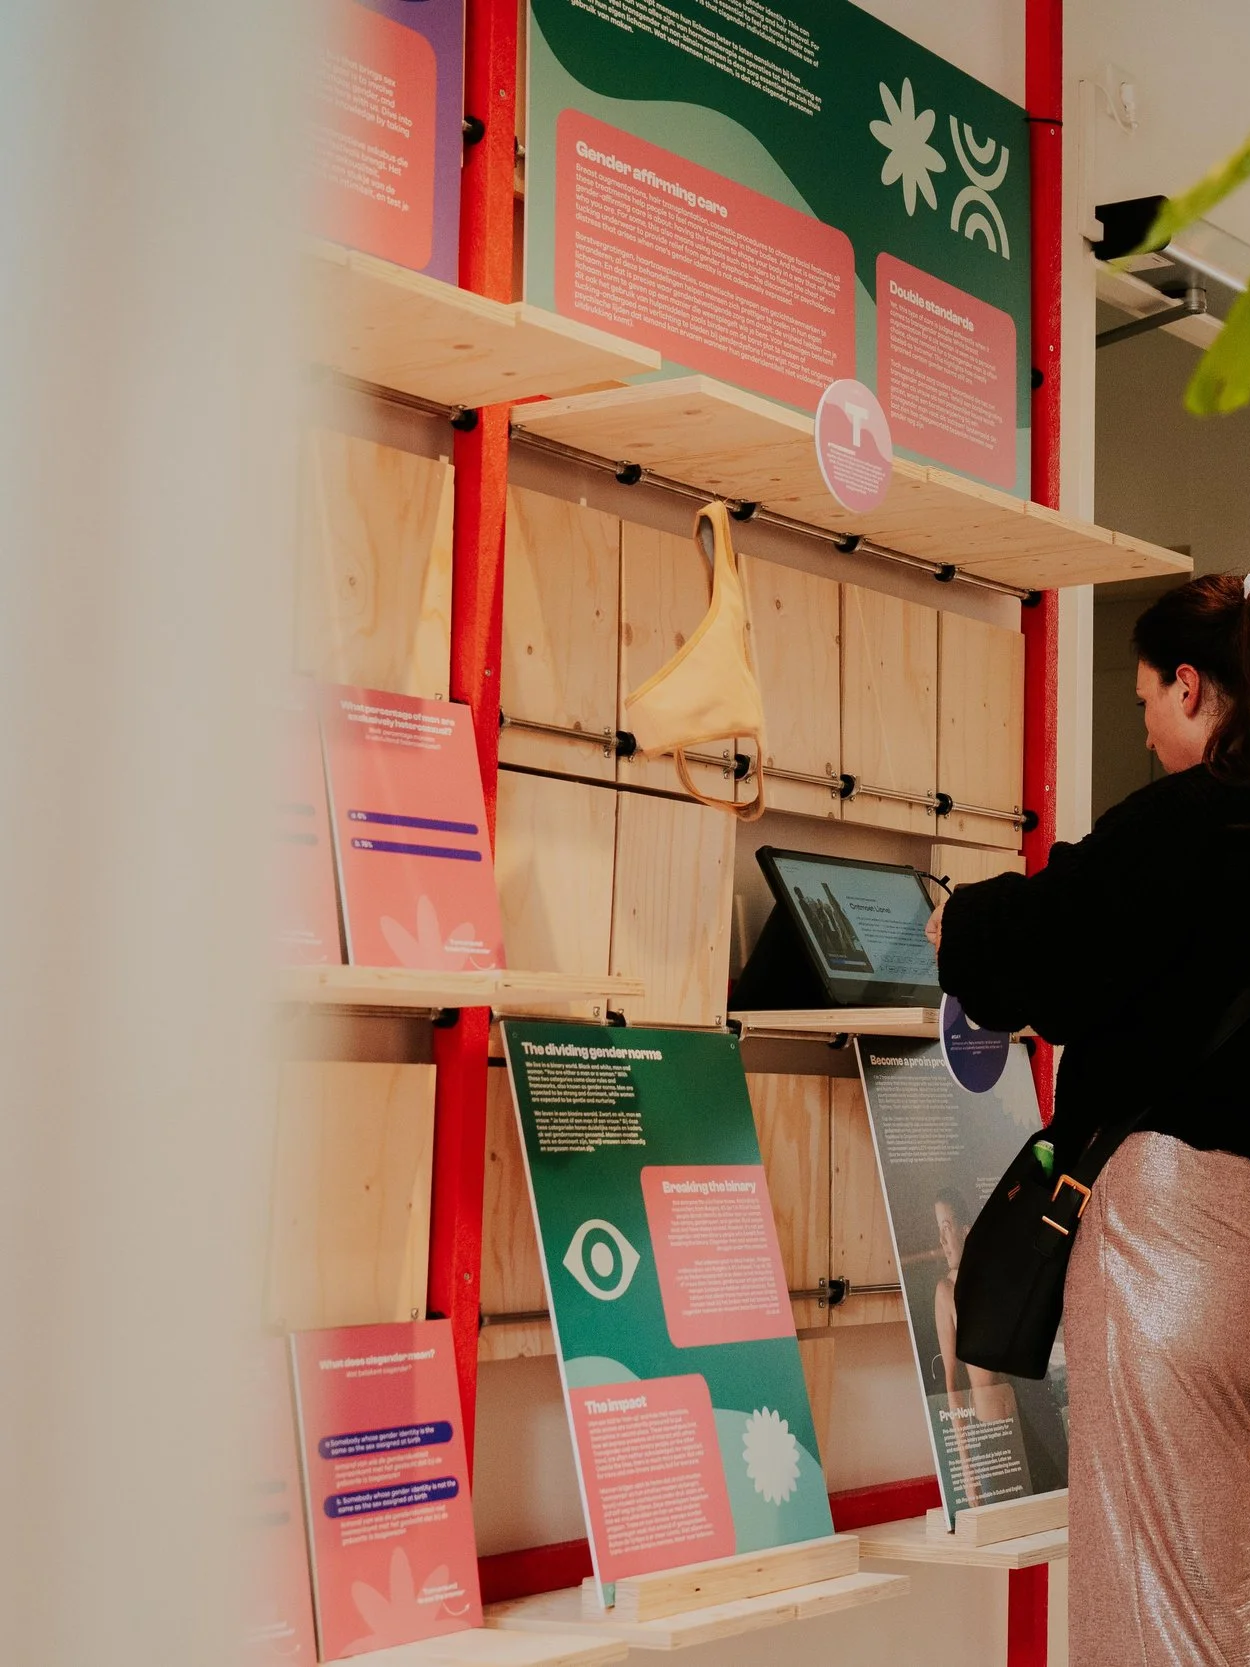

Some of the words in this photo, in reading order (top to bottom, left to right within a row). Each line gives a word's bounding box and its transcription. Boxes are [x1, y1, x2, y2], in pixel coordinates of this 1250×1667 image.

[575, 140, 632, 175] Gender
[632, 167, 696, 206] affirming
[696, 196, 728, 218] care
[889, 279, 924, 308] Double
[924, 299, 974, 332] standards
[521, 1041, 544, 1055] The
[544, 1043, 589, 1059] dividing
[588, 1046, 628, 1060] gender
[627, 1048, 662, 1060] norms
[870, 1055, 903, 1065] Become
[904, 1058, 909, 1066] a
[909, 1058, 923, 1068] pro
[924, 1056, 931, 1066] in
[932, 1058, 949, 1068] pro
[662, 1180, 709, 1195] Breaking
[708, 1180, 726, 1192] the
[724, 1180, 756, 1193] binary
[584, 1400, 608, 1414] The
[607, 1395, 647, 1413] impact
[938, 1406, 976, 1422] Pro-Now
